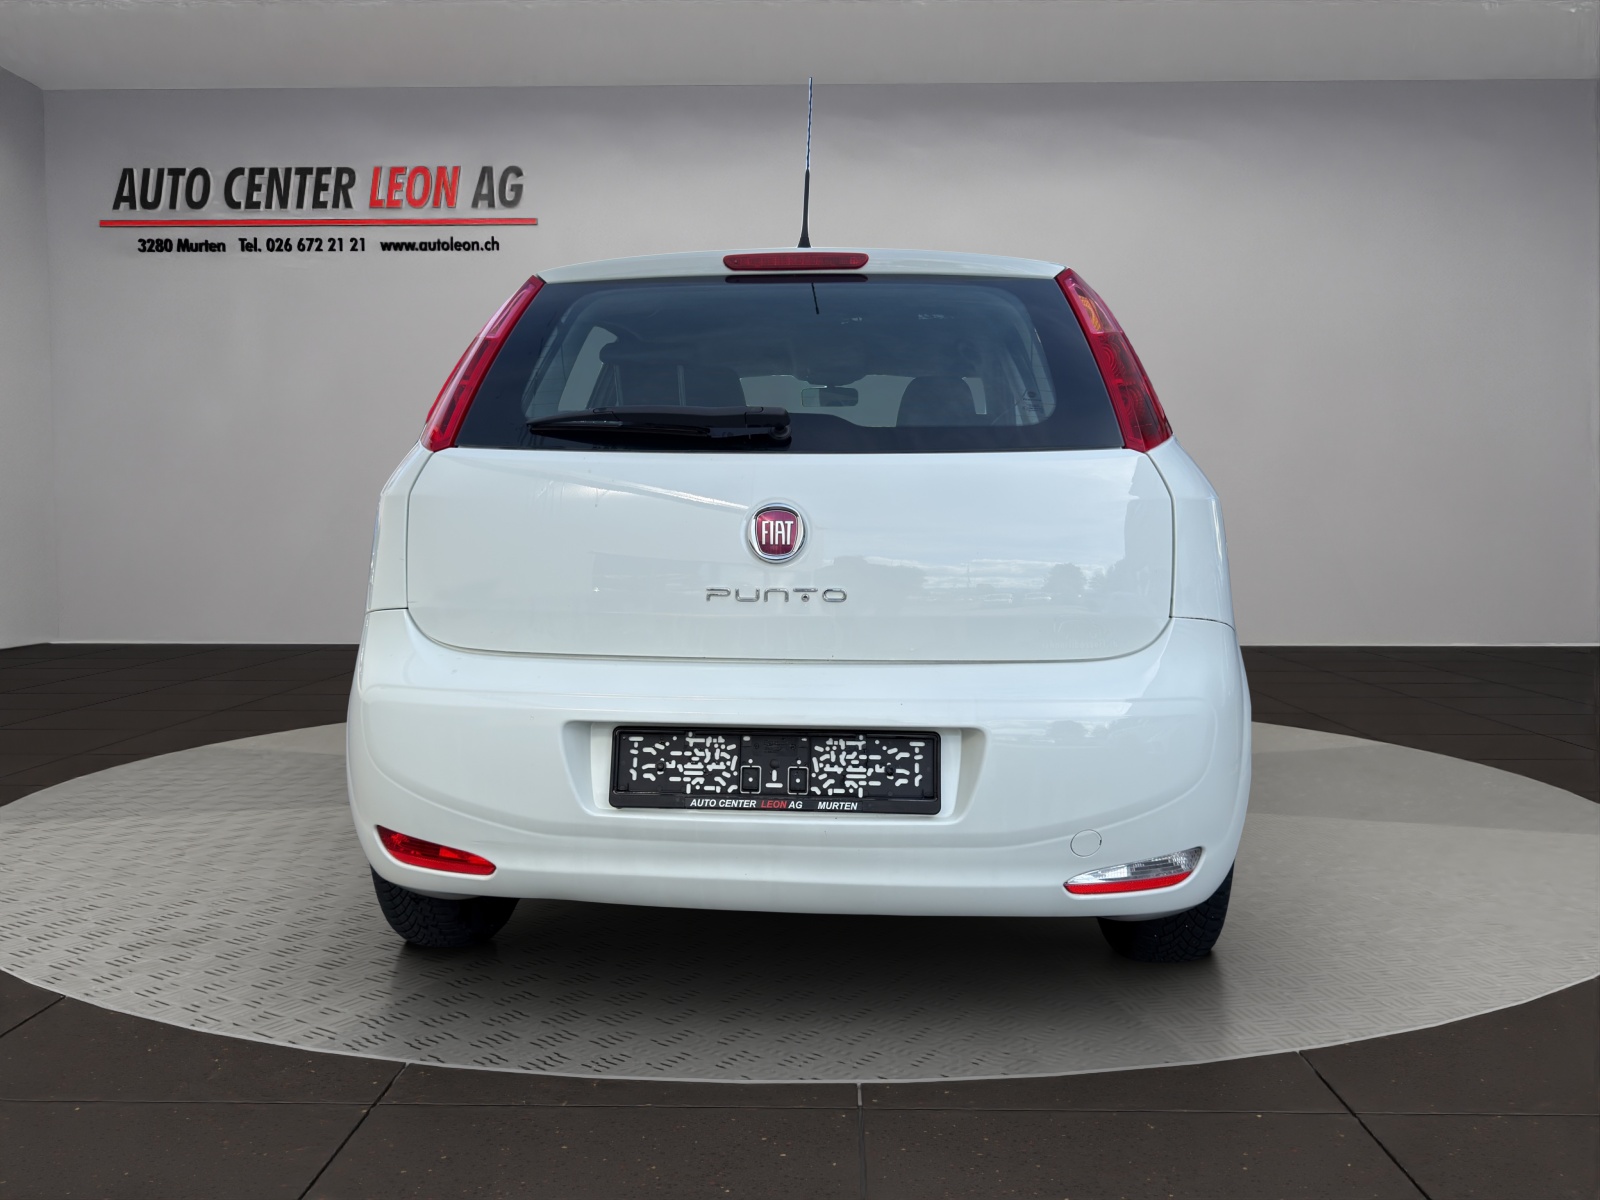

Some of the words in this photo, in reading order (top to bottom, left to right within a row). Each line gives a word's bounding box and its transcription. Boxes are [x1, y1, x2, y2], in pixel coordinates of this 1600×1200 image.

[112, 166, 211, 211] AUTO
[223, 166, 357, 210] CENTER
[368, 165, 461, 209] LEON
[471, 165, 524, 209] AG
[137, 238, 173, 253] 3280
[176, 238, 226, 252] Murten
[238, 237, 262, 252] Tel.
[266, 237, 293, 252] 026
[297, 237, 323, 252] 672
[327, 237, 344, 252] 21
[350, 237, 366, 252] 21
[380, 236, 500, 251] www.autoleon.ch
[761, 520, 794, 546] FIAT
[706, 588, 847, 603] PUNTO
[689, 798, 717, 808] AUTO
[718, 799, 757, 808] CENTER
[760, 800, 788, 809] LEON
[788, 800, 803, 809] AG
[817, 801, 859, 811] MURTEN
